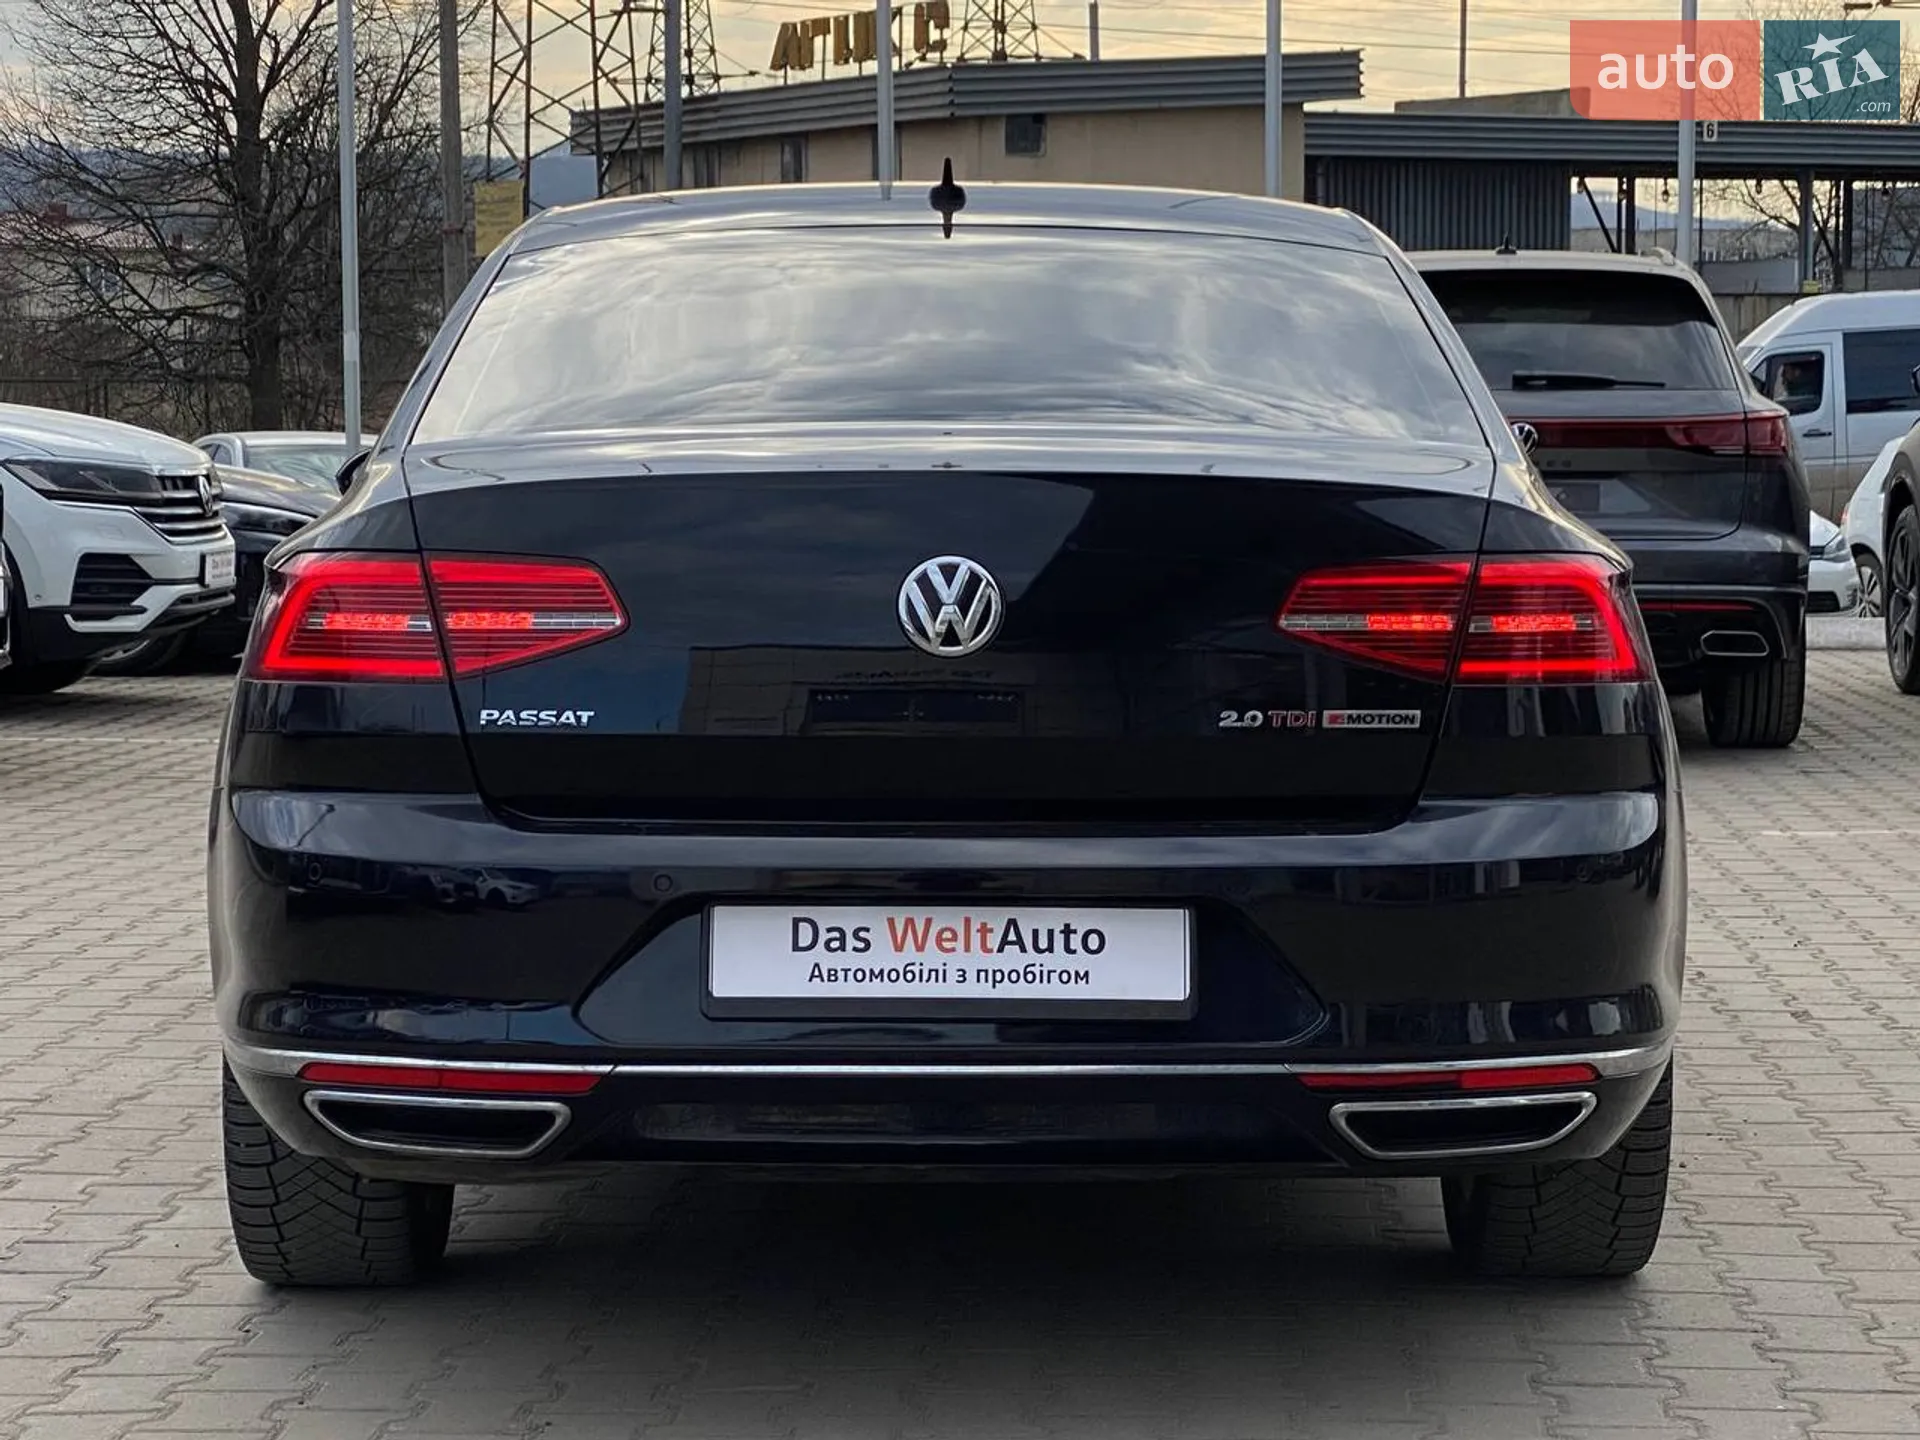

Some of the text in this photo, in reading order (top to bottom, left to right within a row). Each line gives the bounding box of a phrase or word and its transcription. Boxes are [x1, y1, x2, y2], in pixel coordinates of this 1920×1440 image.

[1705, 123, 1715, 140] 6
[479, 709, 595, 727] PASSAT
[1218, 709, 1264, 728] 2.0
[1268, 710, 1317, 728] TDI
[791, 916, 1107, 955] Das WeltAuto
[808, 961, 1091, 990] Автомобілі з пробігом
